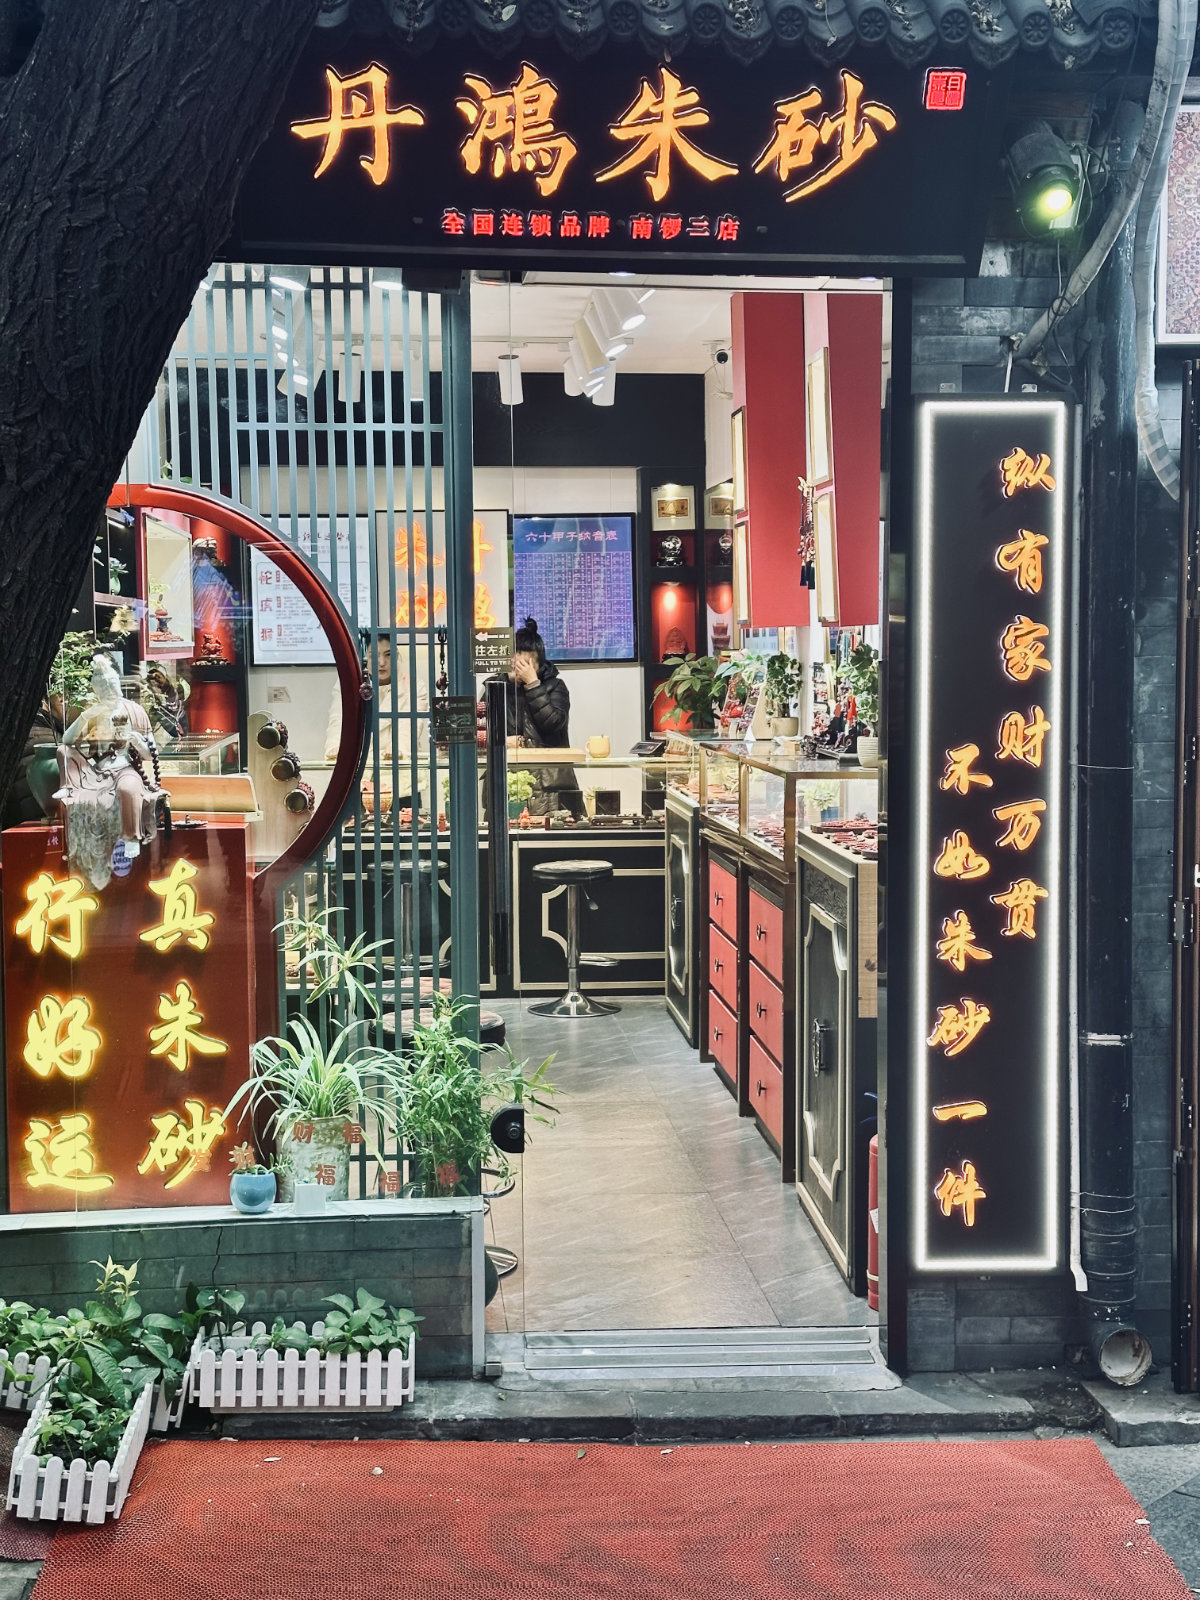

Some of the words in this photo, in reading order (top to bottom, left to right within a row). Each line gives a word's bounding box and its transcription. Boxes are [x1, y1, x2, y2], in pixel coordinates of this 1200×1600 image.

[442, 210, 610, 238] 全国连锁品牌
[993, 447, 1057, 940] 纵有家财万贯
[928, 743, 994, 1228] 不如朱砂一件
[15, 872, 115, 1192] 行好运
[138, 857, 228, 1190] 真朱砂
[293, 1122, 315, 1144] 财
[342, 1122, 363, 1145] 福
[315, 1163, 336, 1186] 福
[381, 1170, 401, 1193] 福
